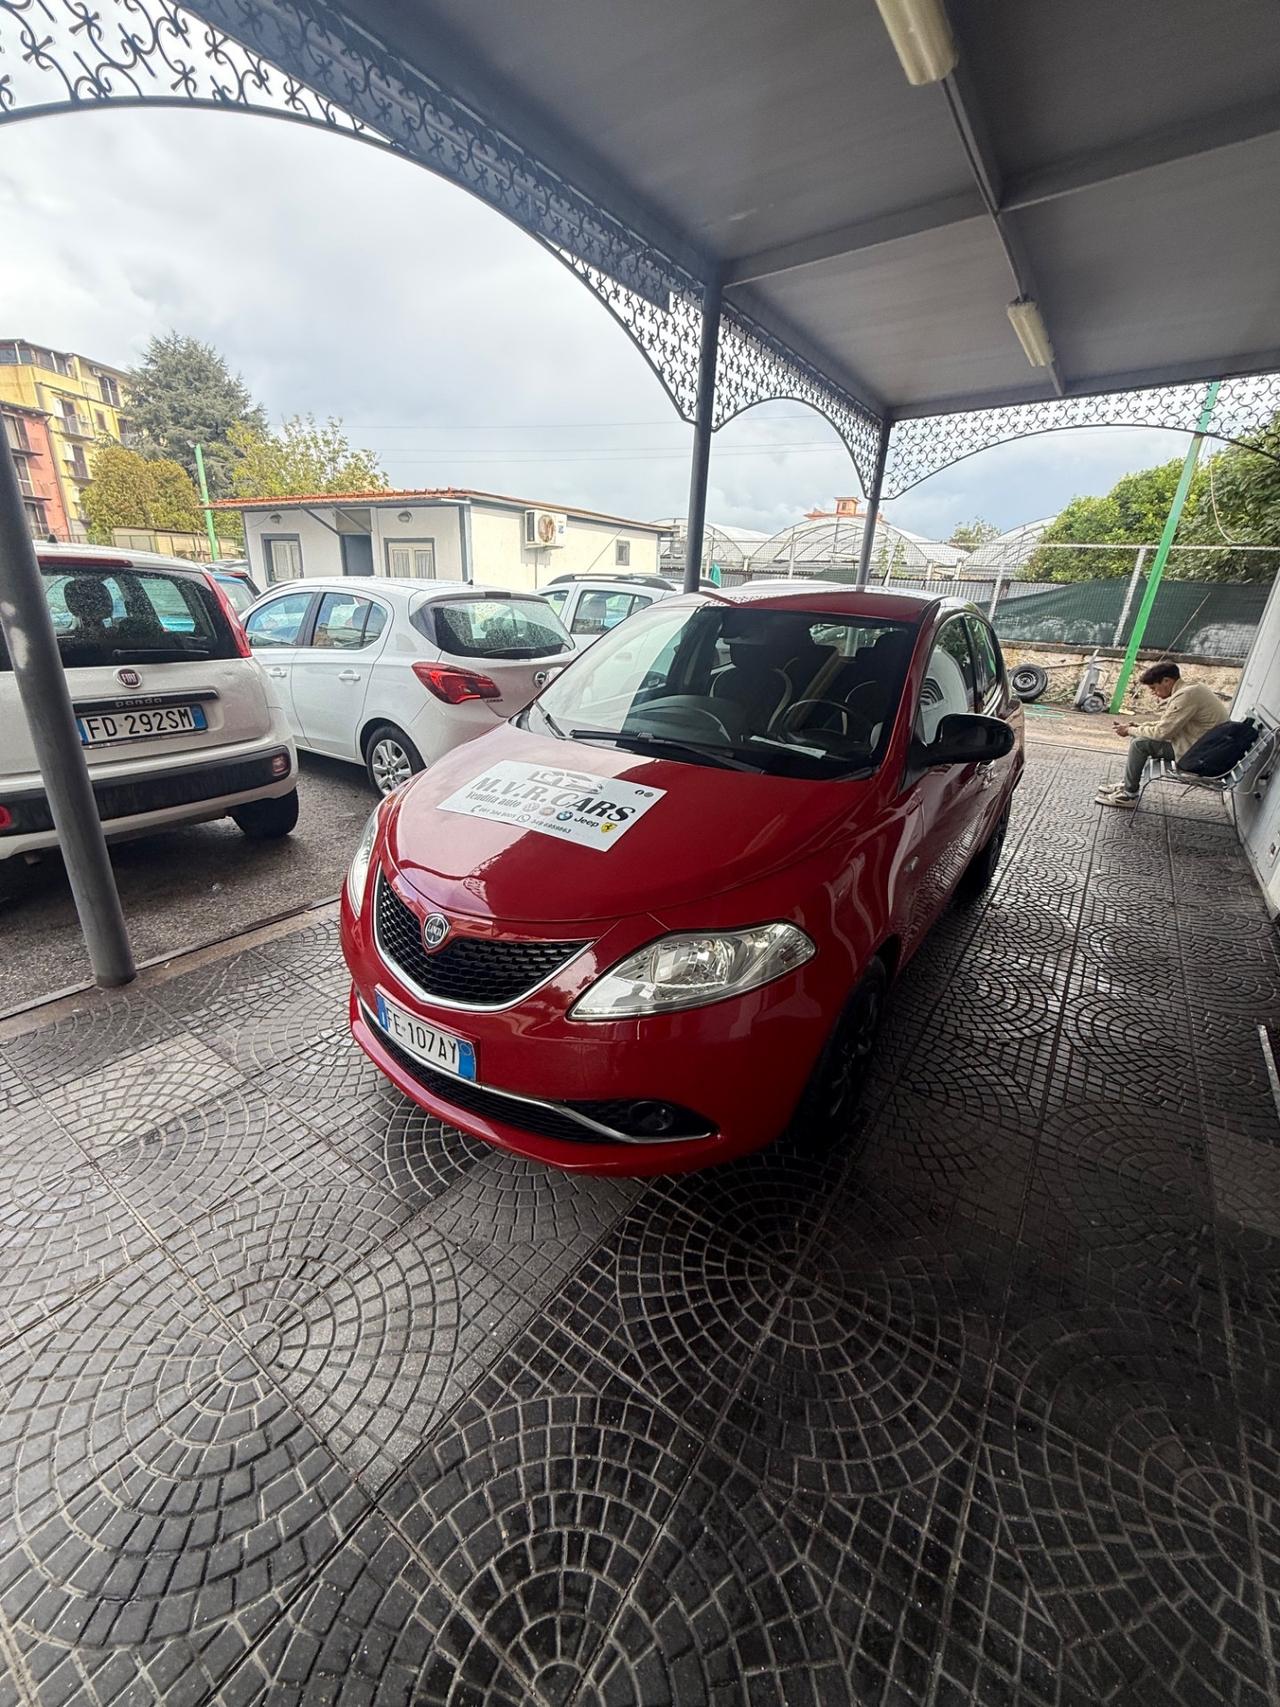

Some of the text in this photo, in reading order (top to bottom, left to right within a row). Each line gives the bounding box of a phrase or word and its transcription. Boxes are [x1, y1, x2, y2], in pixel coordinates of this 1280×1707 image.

[121, 673, 138, 683] FIAT
[115, 697, 163, 708] panda
[86, 708, 193, 739] FD 292SM
[498, 799, 521, 808] auto
[574, 817, 600, 827] Jeep
